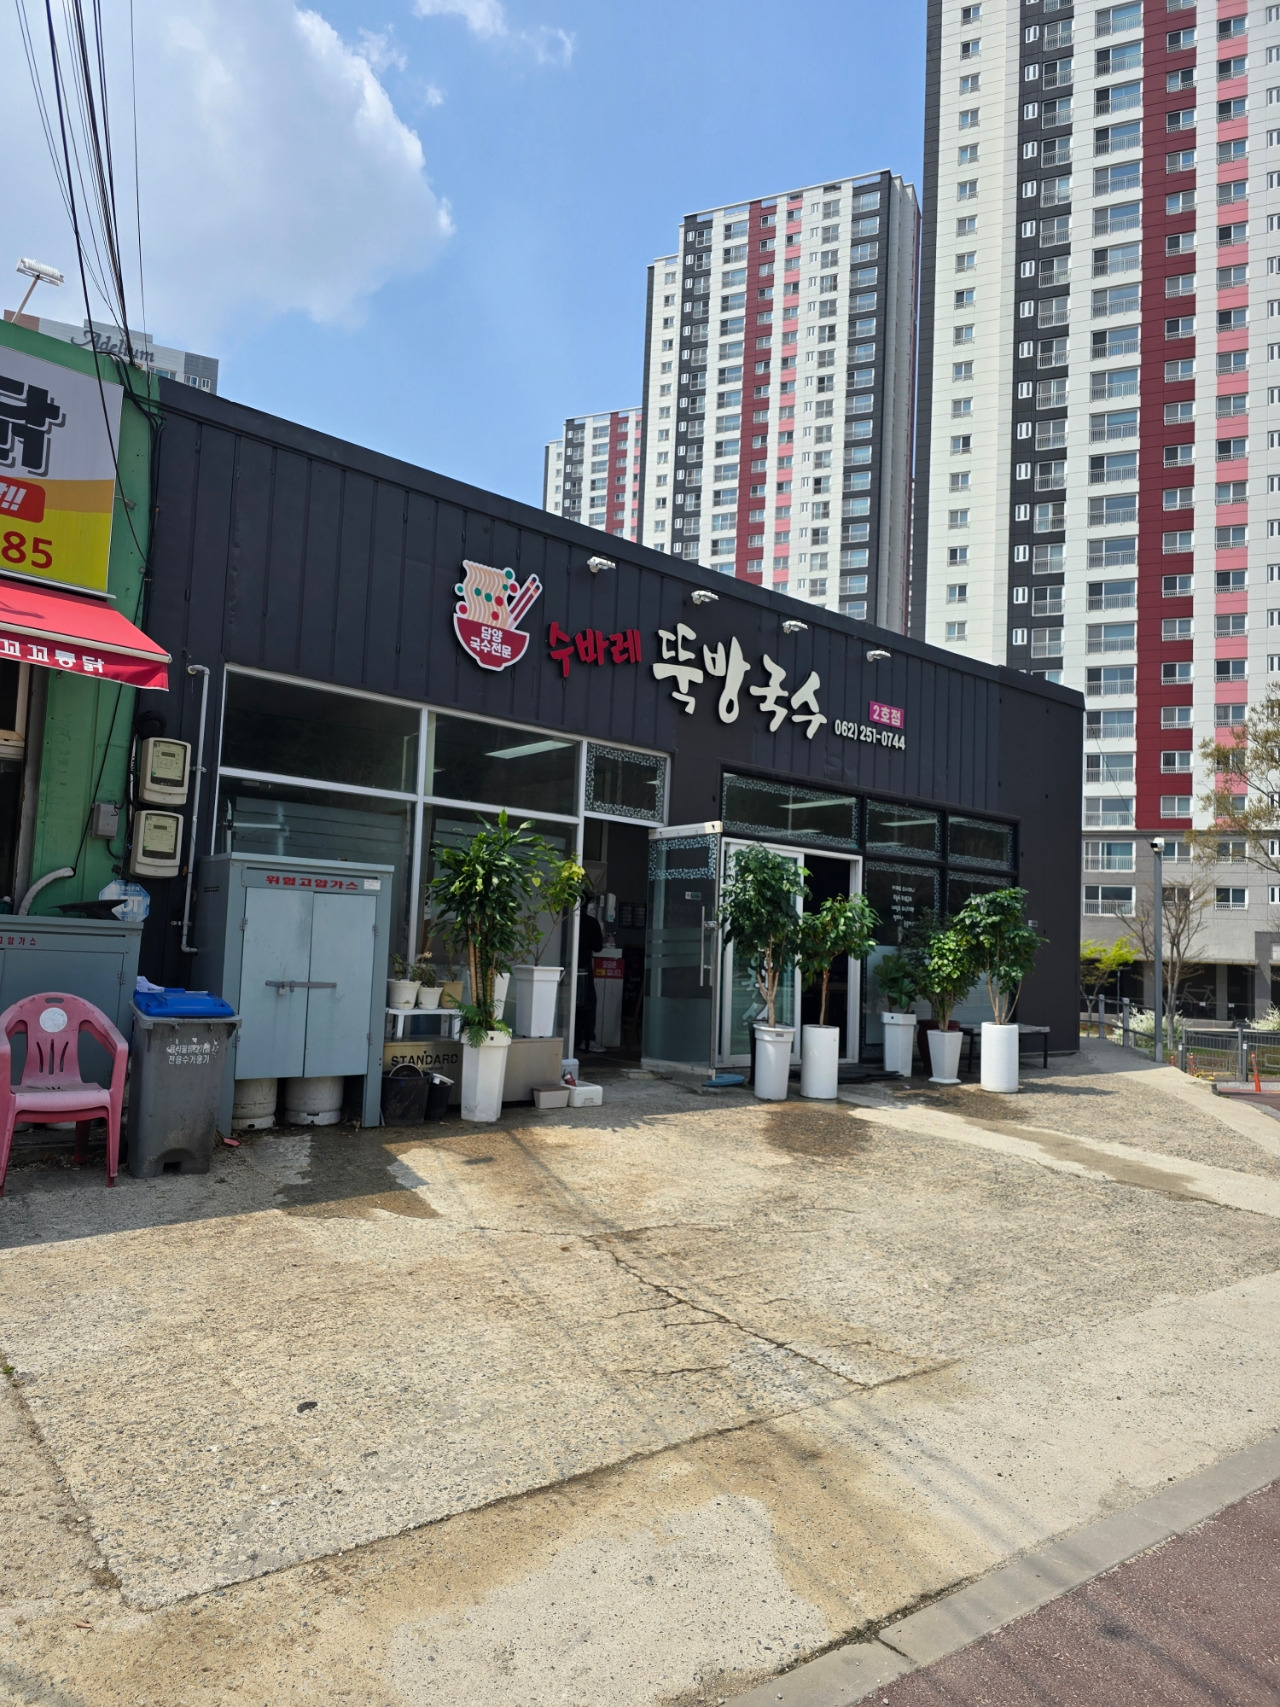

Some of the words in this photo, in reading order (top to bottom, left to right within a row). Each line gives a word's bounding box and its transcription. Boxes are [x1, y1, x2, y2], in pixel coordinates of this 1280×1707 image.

[480, 625, 504, 643] 담양
[469, 635, 512, 660] 국수전문
[549, 621, 642, 679] 수바레
[652, 622, 828, 740] 뚝방국수
[872, 705, 901, 727] 2호점
[859, 725, 906, 751] 251-0744
[168, 1055, 210, 1065] 전용수거용기
[391, 1053, 459, 1067] STANDARD
